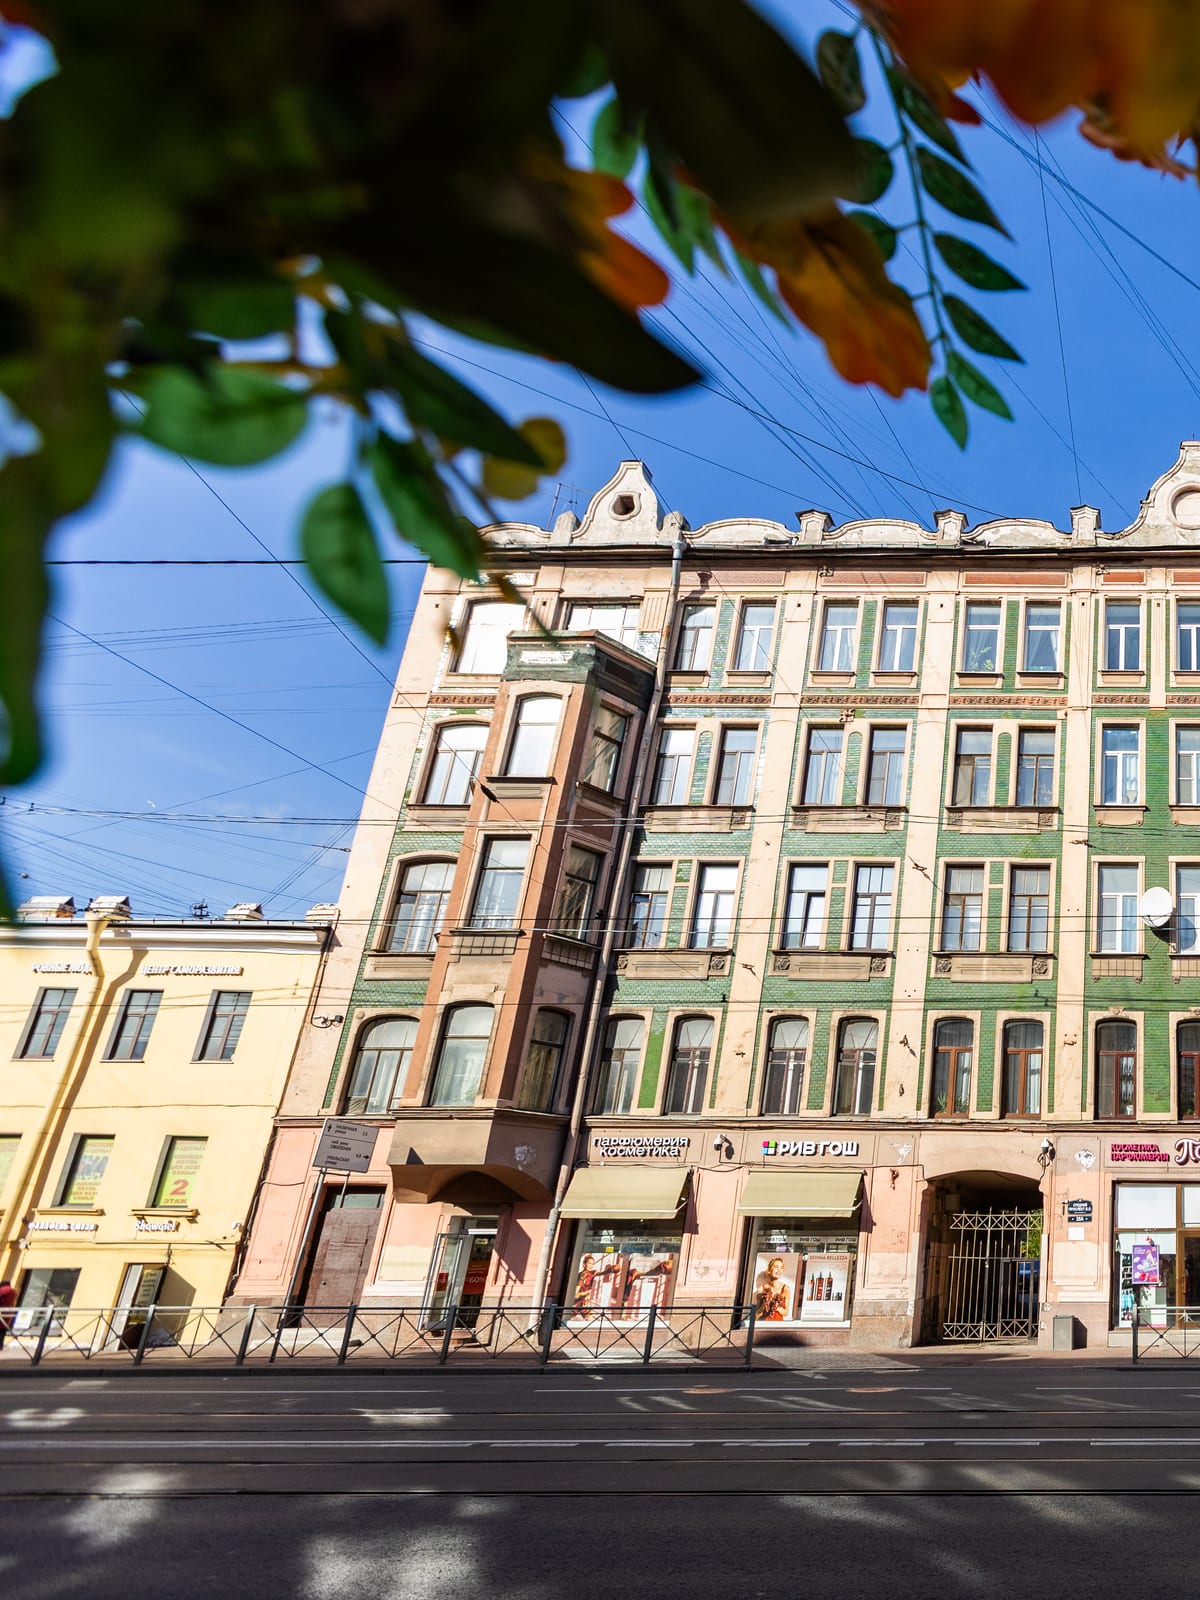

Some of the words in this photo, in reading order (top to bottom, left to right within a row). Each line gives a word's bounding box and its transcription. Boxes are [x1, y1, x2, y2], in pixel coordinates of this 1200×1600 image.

[779, 1140, 817, 1156] РИВ
[819, 1140, 859, 1156] ГОШ
[1110, 1144, 1160, 1152] КОСМЕТИКА
[1111, 1153, 1170, 1162] ПАРФЮМЕРИЯ
[170, 1179, 189, 1196] 2
